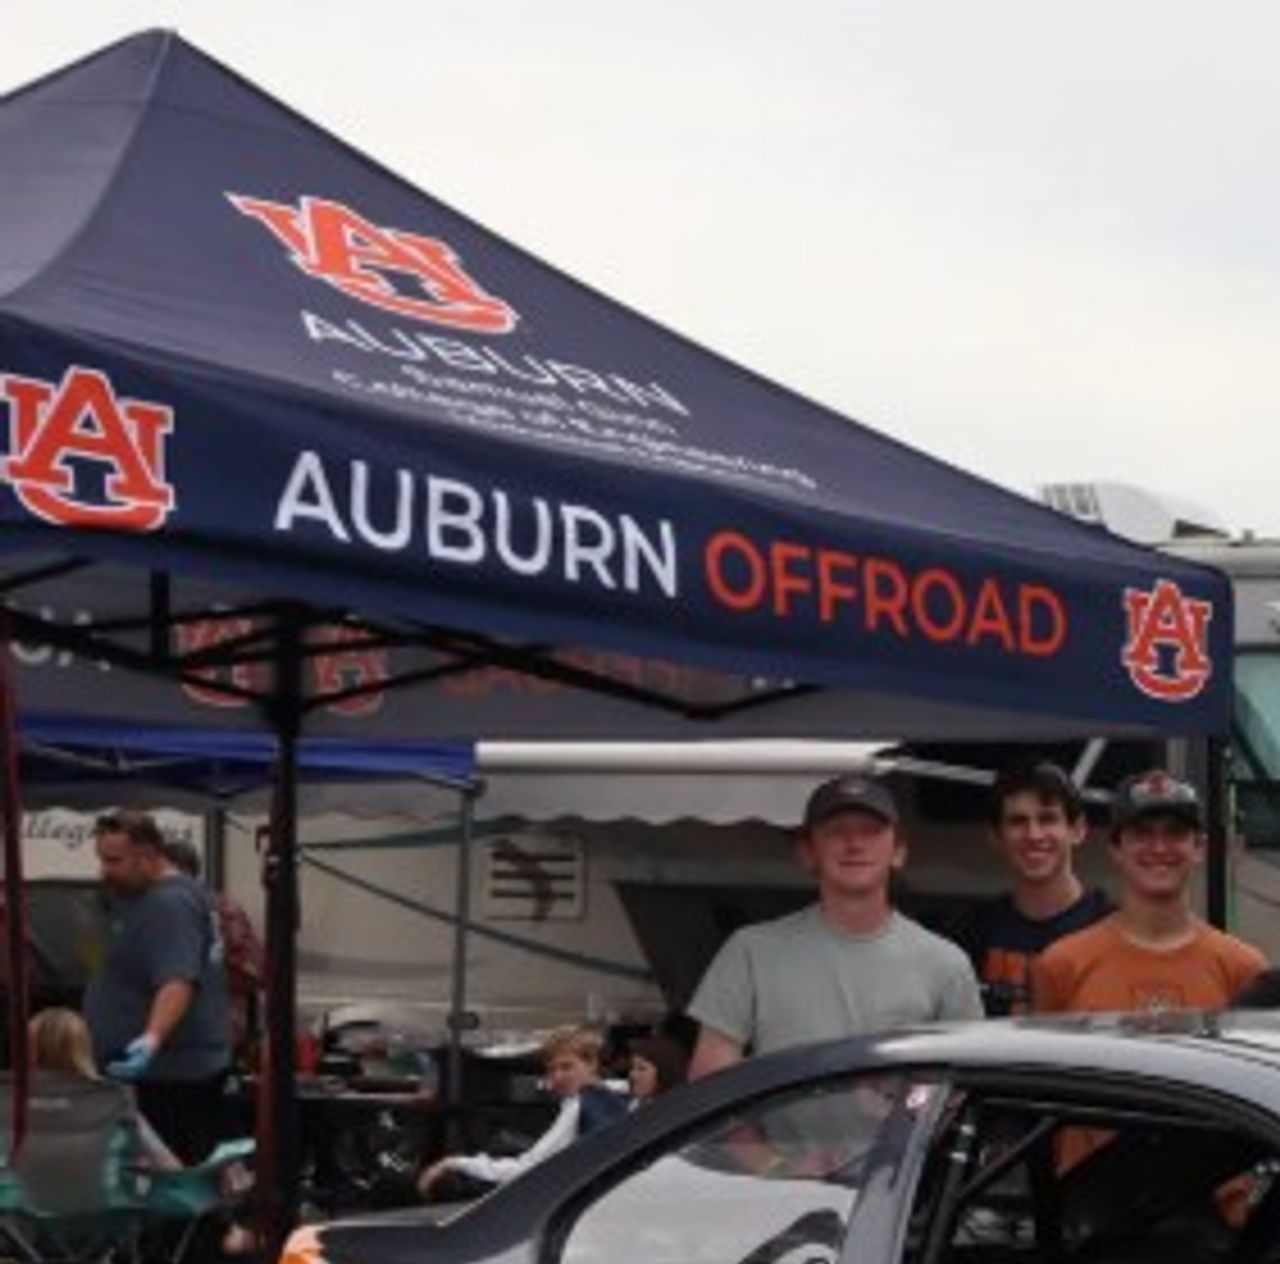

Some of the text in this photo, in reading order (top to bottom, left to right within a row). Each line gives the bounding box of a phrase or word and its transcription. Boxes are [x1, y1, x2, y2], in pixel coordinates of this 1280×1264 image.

[300, 309, 691, 418] AUBURN
[274, 449, 1069, 659] AUBURN OFFROAD
